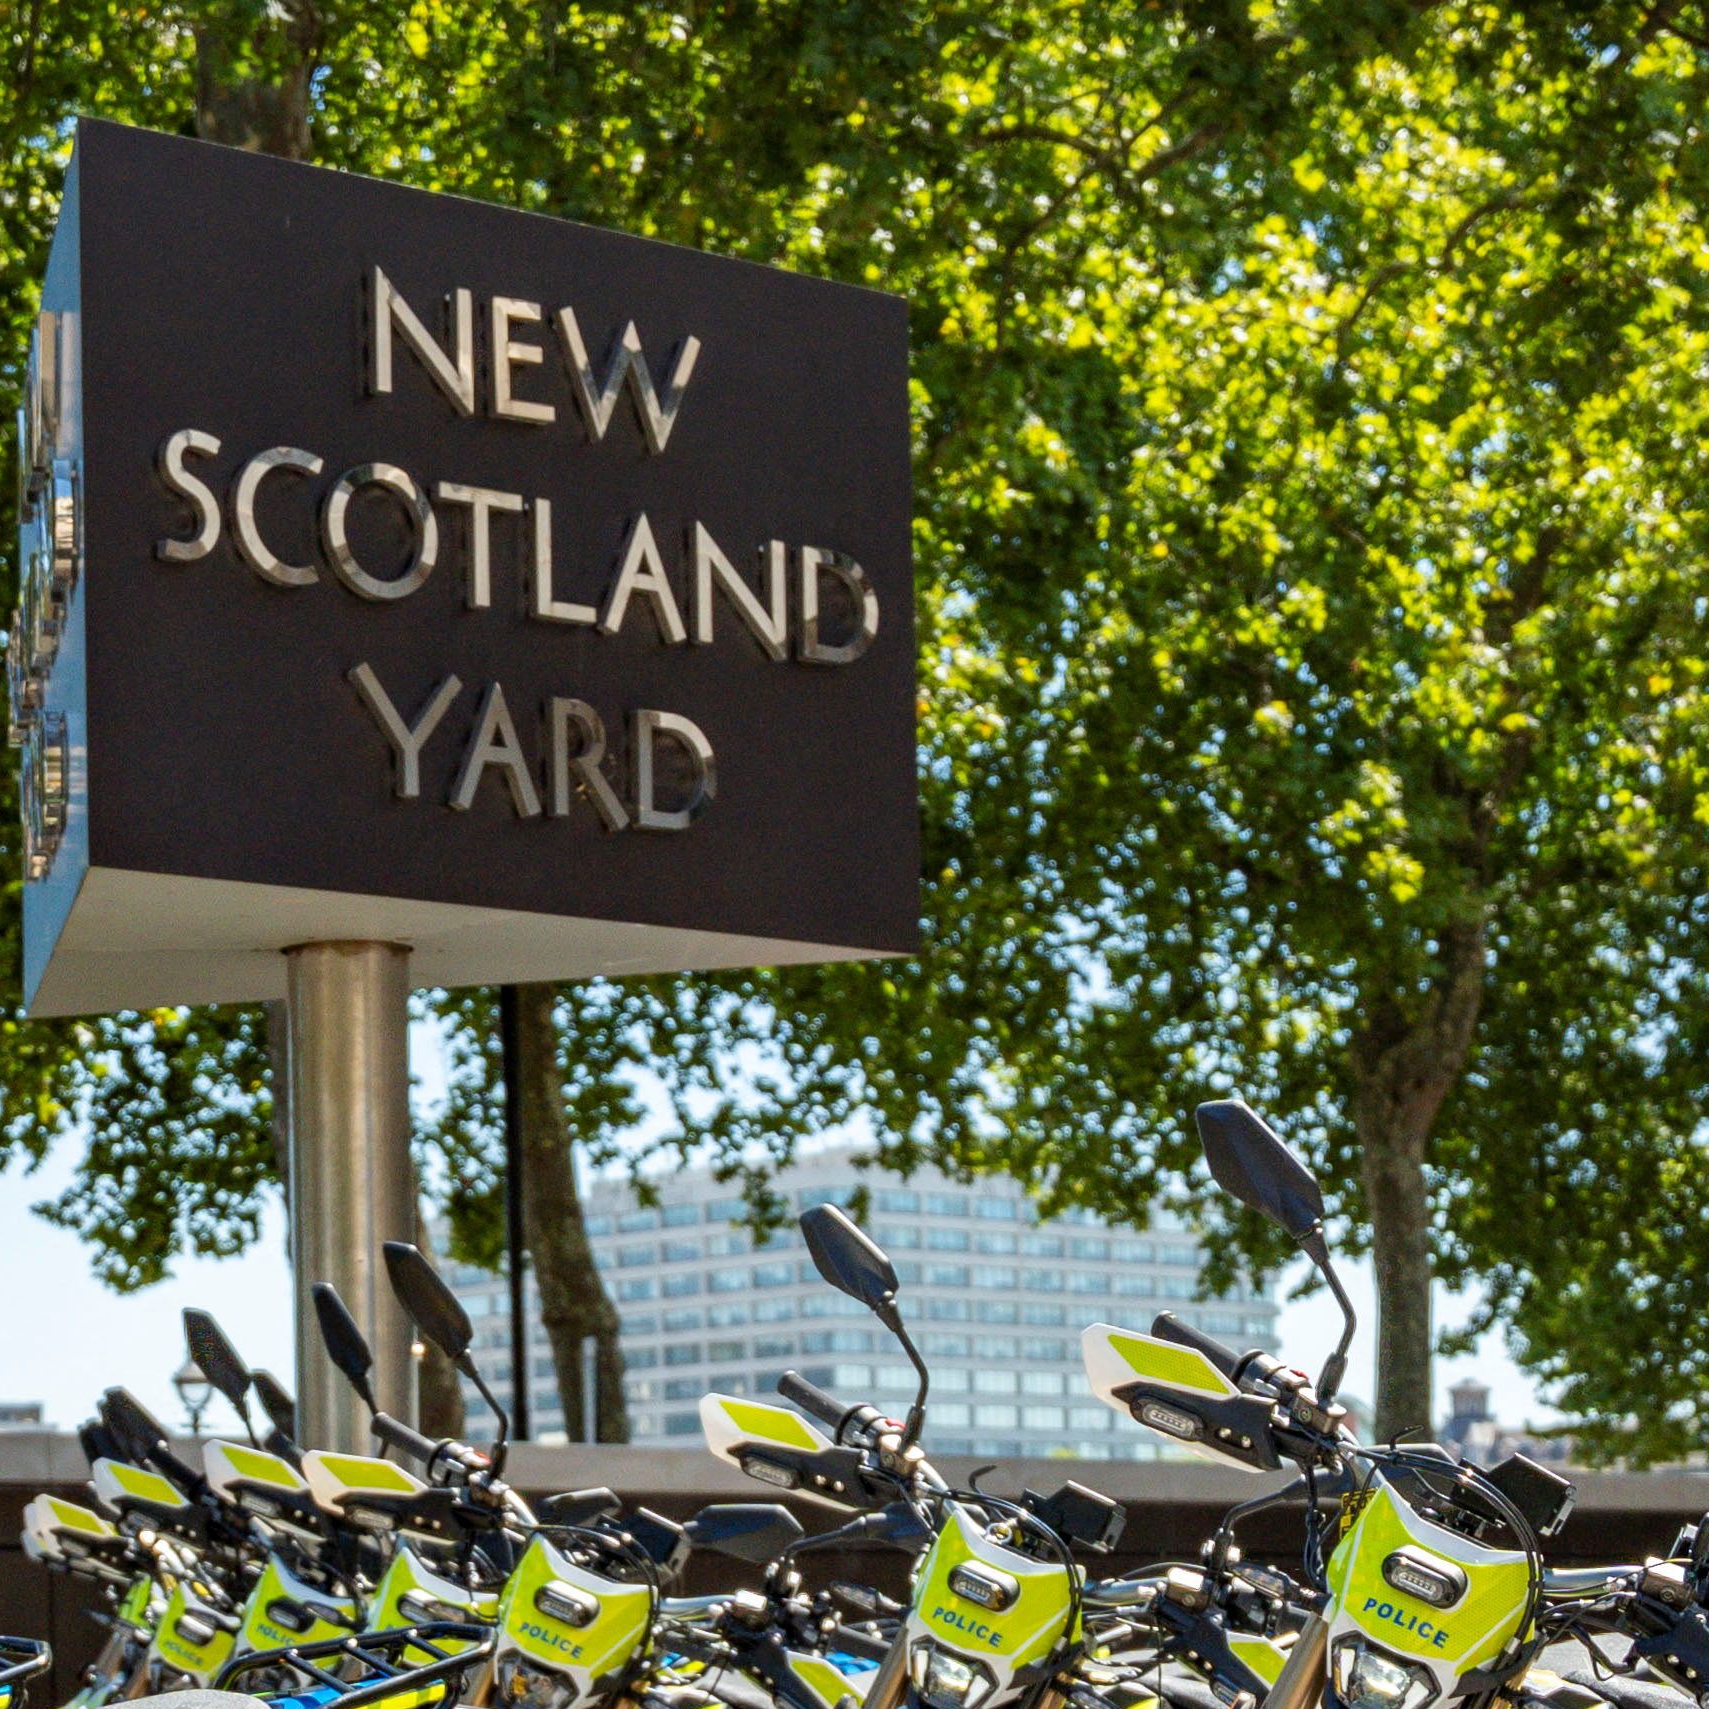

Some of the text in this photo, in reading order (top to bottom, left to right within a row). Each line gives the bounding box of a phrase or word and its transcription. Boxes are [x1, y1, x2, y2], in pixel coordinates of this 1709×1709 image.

[366, 264, 702, 456] NEW
[157, 427, 880, 664] SCOTLAND
[347, 660, 719, 834] YARD
[256, 1623, 294, 1647] POLIC
[519, 1621, 584, 1659] POLICE
[932, 1606, 1003, 1647] POLICE
[1363, 1597, 1449, 1648] POLICE
